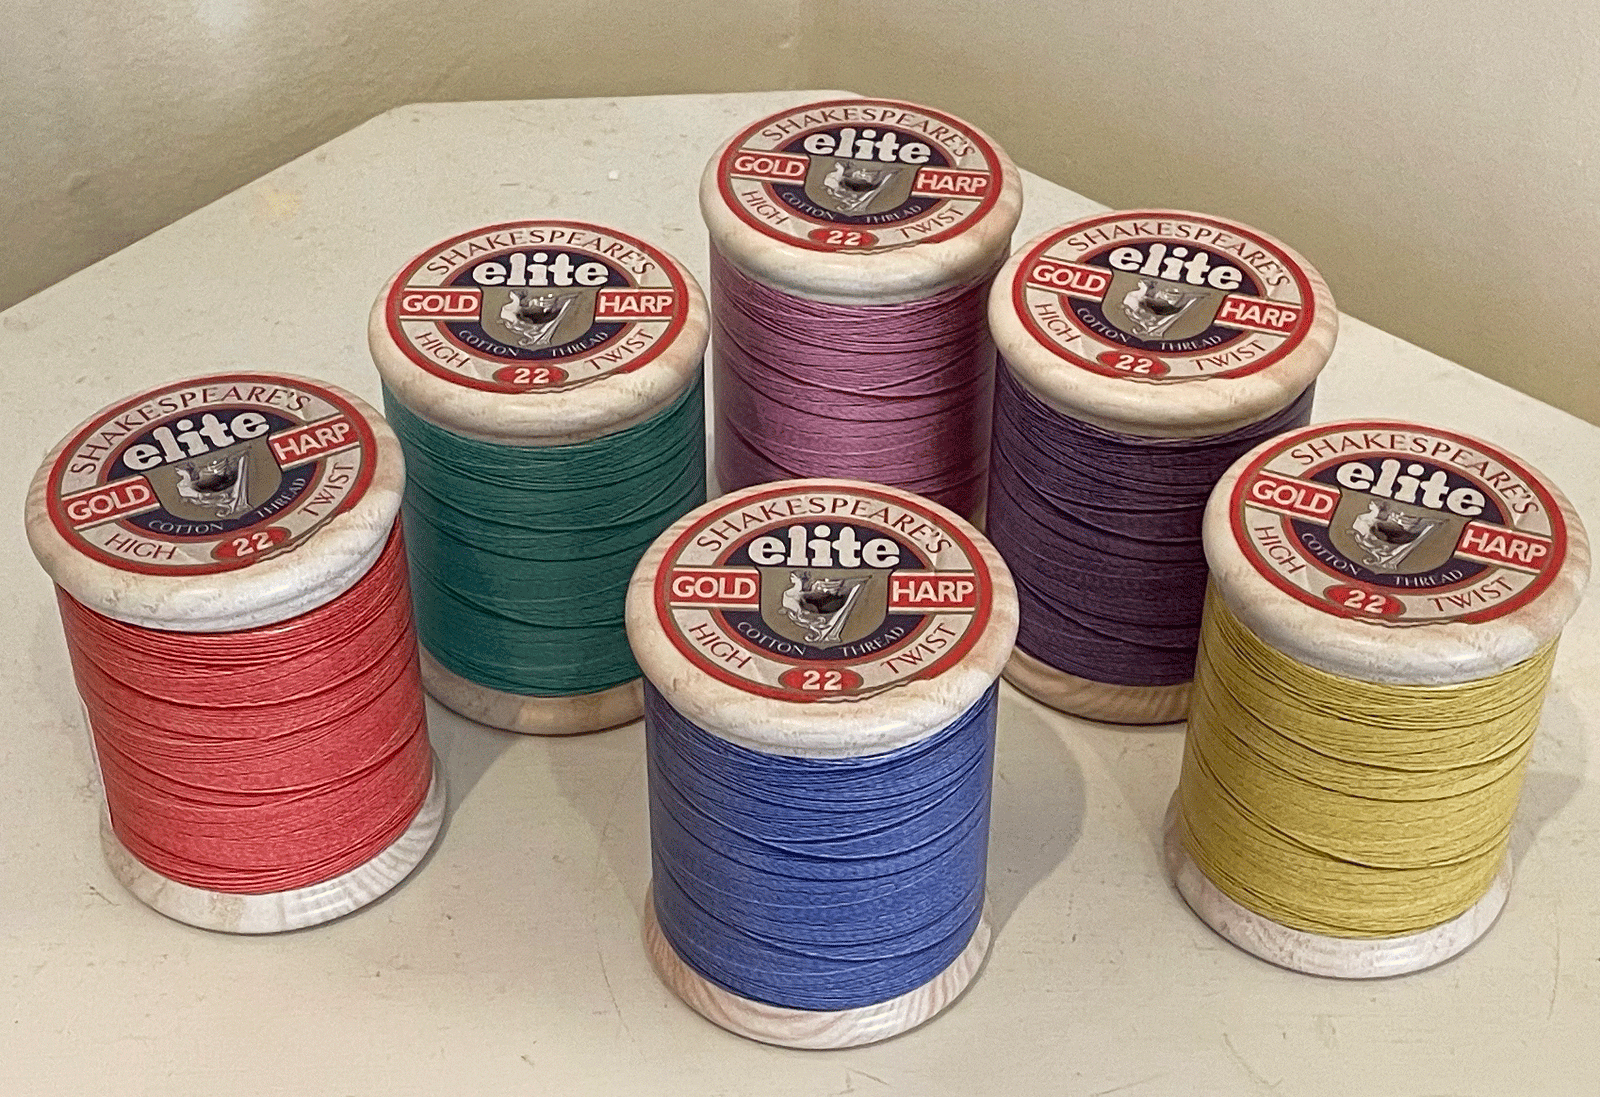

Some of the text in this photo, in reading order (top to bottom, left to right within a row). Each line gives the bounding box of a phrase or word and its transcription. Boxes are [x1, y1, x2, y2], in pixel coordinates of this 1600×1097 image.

[762, 108, 976, 158] SHAKESPEARE'S
[804, 128, 931, 163] elite
[735, 157, 987, 193] GOLD HARP
[741, 190, 966, 239] HIGH TWIST
[783, 192, 922, 224] COTTON THREAD
[427, 229, 655, 275] SHAKESPEARE'S
[827, 230, 862, 245] 22
[1067, 222, 1290, 288] SHAKESPEARE'S
[473, 252, 609, 286] elite
[1109, 243, 1242, 290] elite
[402, 294, 673, 313] GOLD HARP
[1032, 265, 1297, 327] GOLD HARP
[415, 329, 654, 371] HIGH TWIST
[459, 330, 608, 357] COTTON THREAD
[1035, 303, 1269, 371] HIGH TWIST
[1077, 307, 1222, 350] COTTON THREAD
[513, 368, 550, 384] 22
[1114, 354, 1153, 374] 22
[71, 385, 311, 476] SHAKESPEARE'S
[123, 413, 269, 470] elite
[67, 422, 350, 520] GOLD HARP
[1291, 433, 1540, 514] SHAKESPEARE'S
[1336, 460, 1486, 516] elite
[104, 462, 354, 560] HIGH TWIST
[148, 478, 306, 535] COTTON THREAD
[696, 497, 952, 554] SHAKESPEARE'S
[1252, 480, 1547, 562] GOLD HARP
[232, 532, 273, 557] 22
[748, 525, 900, 567] elite
[1301, 532, 1463, 586] COTTON THREAD
[673, 577, 974, 602] GOLD HARP
[1254, 526, 1515, 612] HIGH TWIST
[1344, 590, 1386, 614] 22
[689, 623, 957, 675] HIGH TWIST
[737, 622, 905, 656] COTTON THREAD
[802, 670, 842, 691] 22
